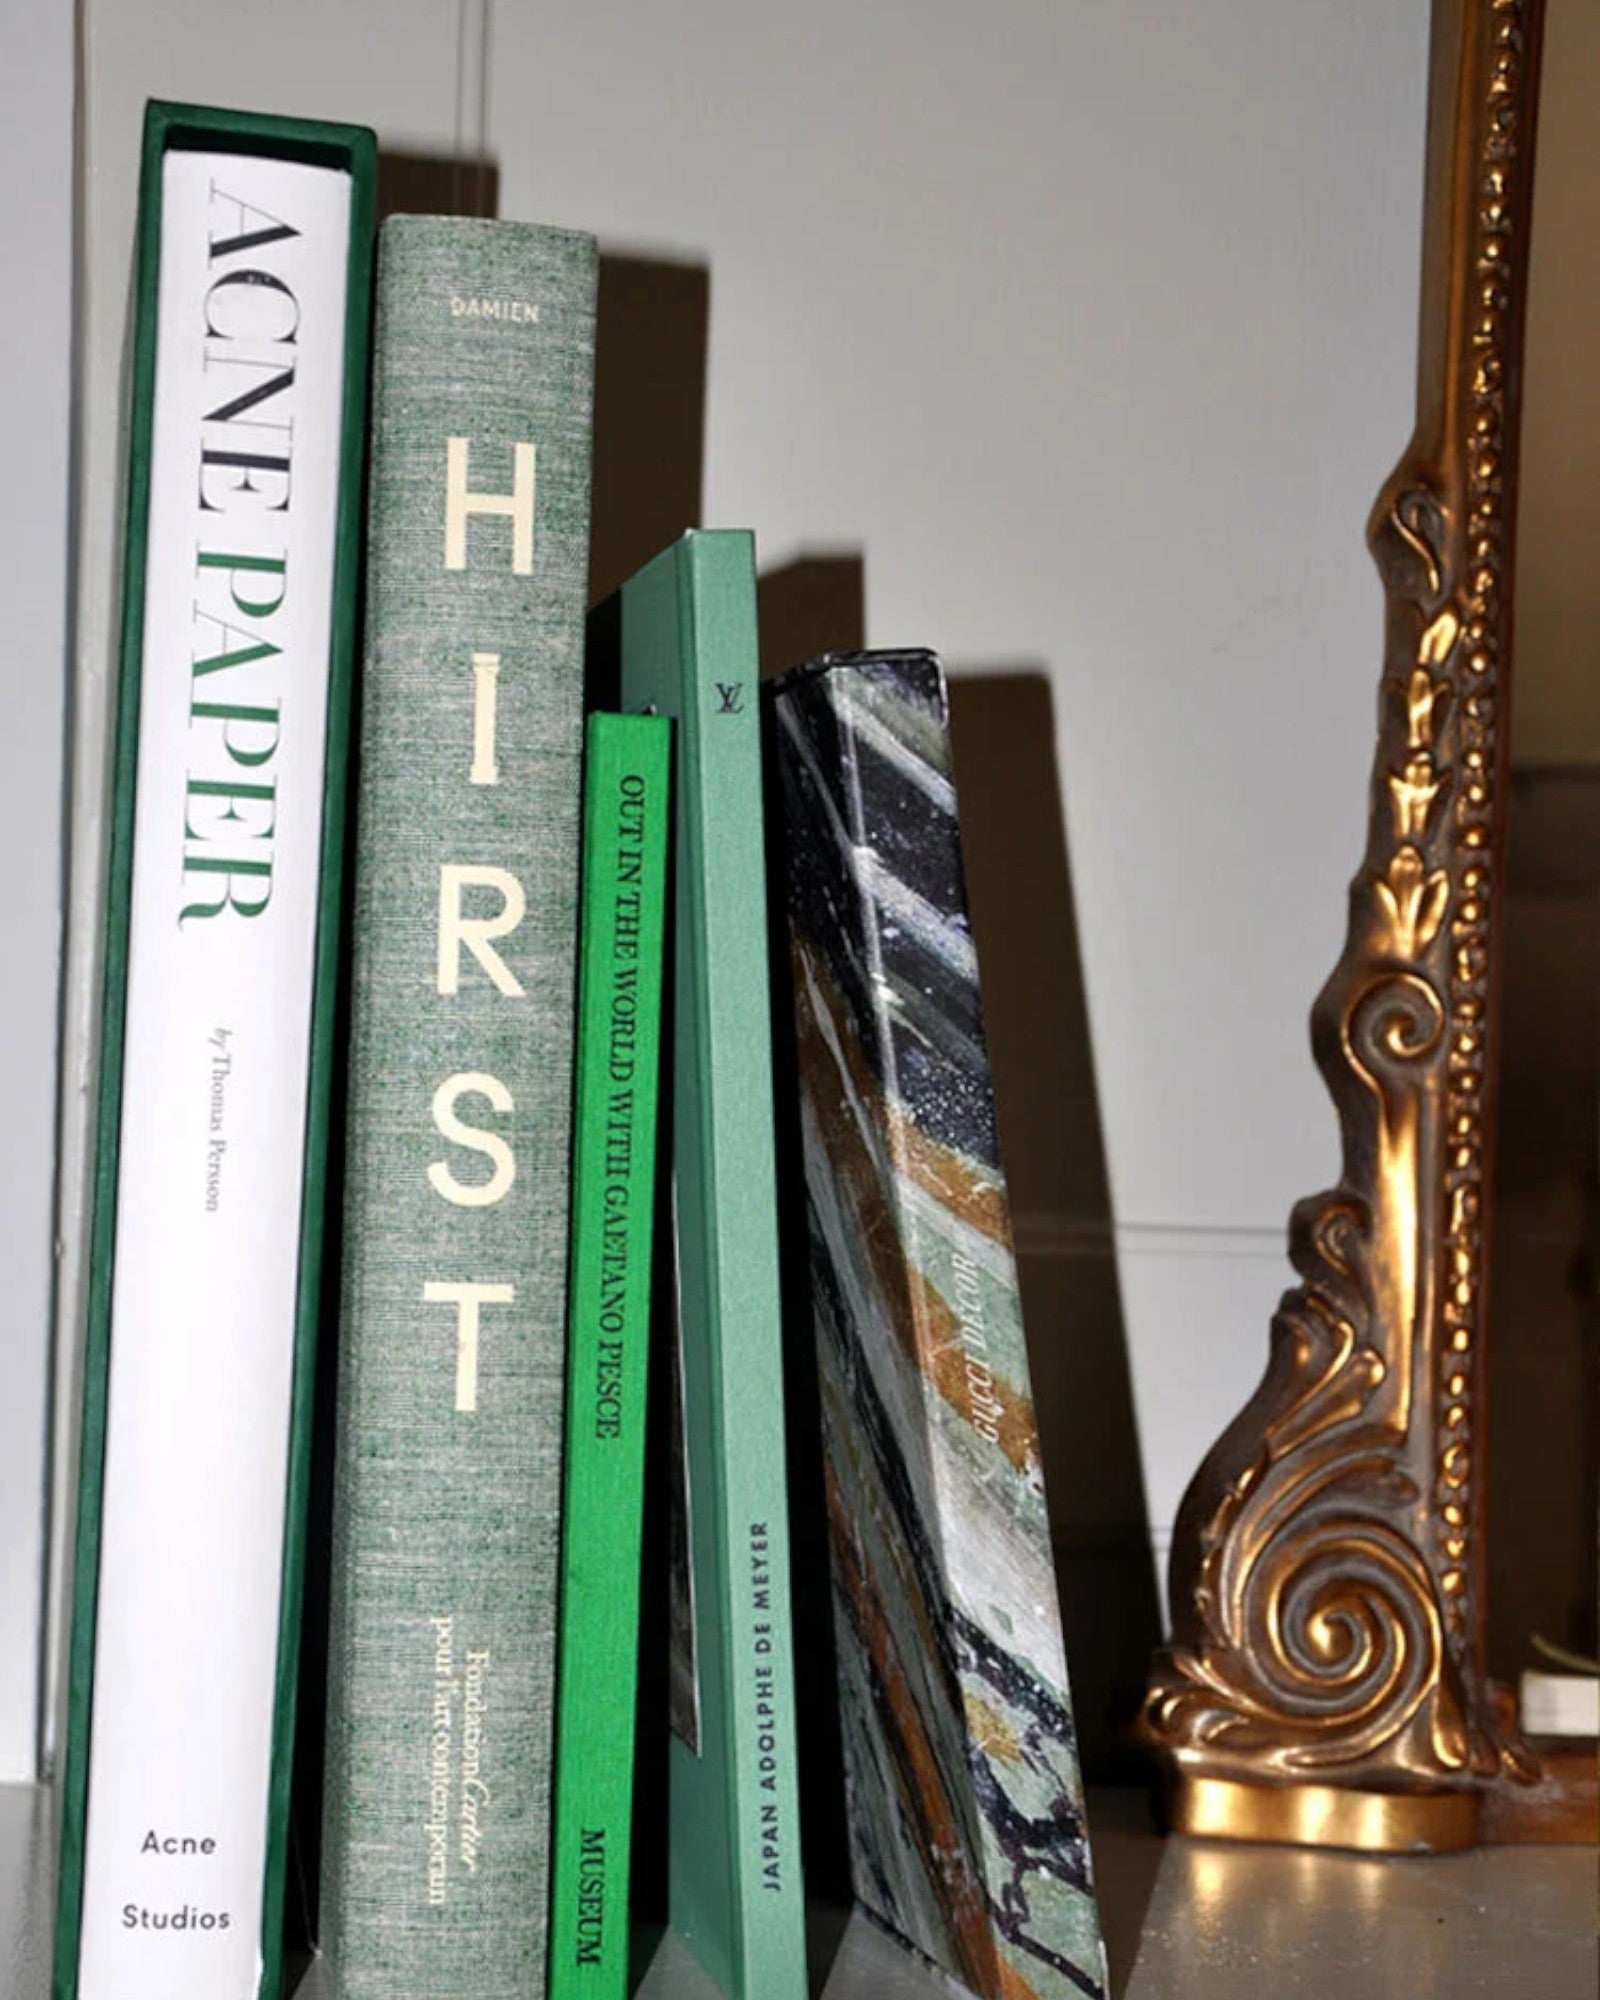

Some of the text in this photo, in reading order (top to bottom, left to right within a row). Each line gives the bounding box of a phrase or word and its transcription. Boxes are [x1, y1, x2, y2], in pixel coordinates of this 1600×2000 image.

[450, 296, 539, 323] DAMIEN
[177, 177, 302, 933] ACNE PAPER
[423, 437, 536, 1412] HIRST
[206, 1027, 233, 1212] by Thomas Persson
[595, 774, 646, 1440] OUT IN THE WORLD WITH GAETANO PESCE
[965, 1352, 999, 1443] GUCCI
[430, 1616, 453, 1676] pour
[750, 1521, 782, 1892] JAPAN ADOLPHE DE MEYER
[140, 1828, 216, 1855] Acne
[424, 1731, 451, 1904] contemporain
[460, 1650, 491, 1873] Fondation Cartier
[122, 1903, 231, 1930] Studios
[576, 1827, 606, 1968] MUSEUM
